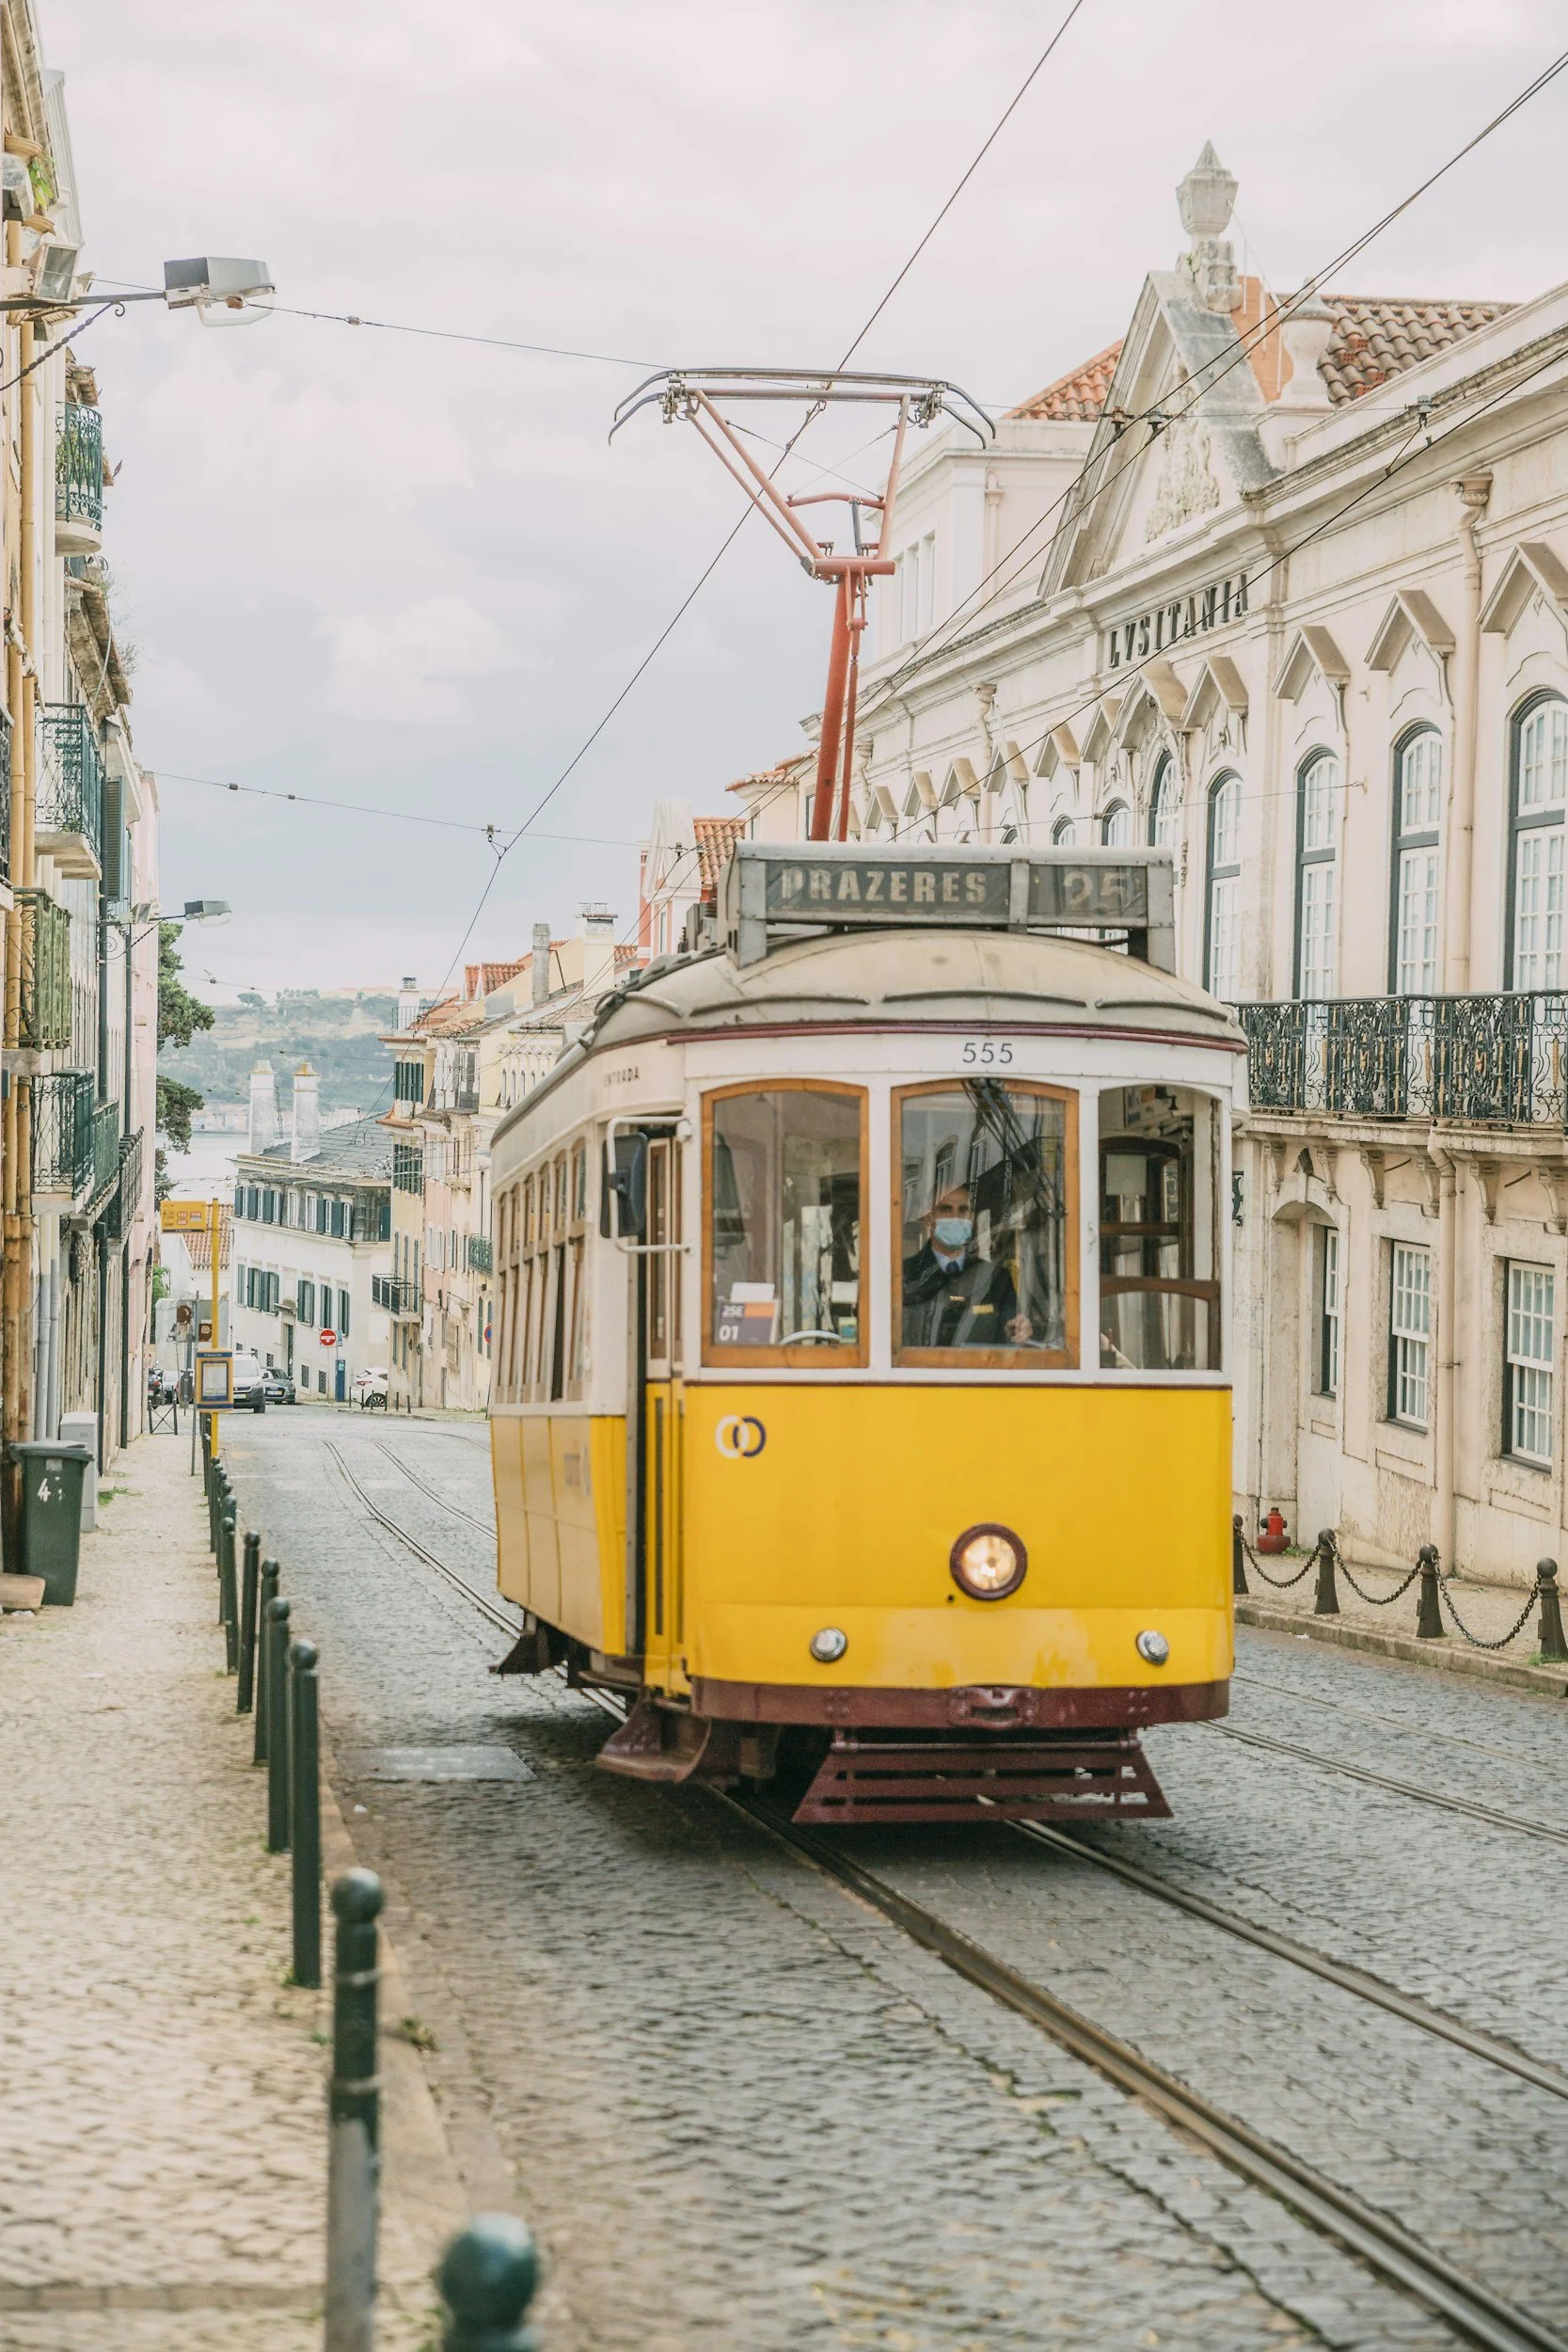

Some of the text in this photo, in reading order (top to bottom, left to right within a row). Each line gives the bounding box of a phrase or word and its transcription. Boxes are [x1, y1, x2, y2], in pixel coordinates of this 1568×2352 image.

[1109, 574, 1248, 669] LVSITANIA
[781, 868, 988, 903] PRAZERES
[962, 1042, 1013, 1064] 555
[719, 1325, 739, 1342] 01
